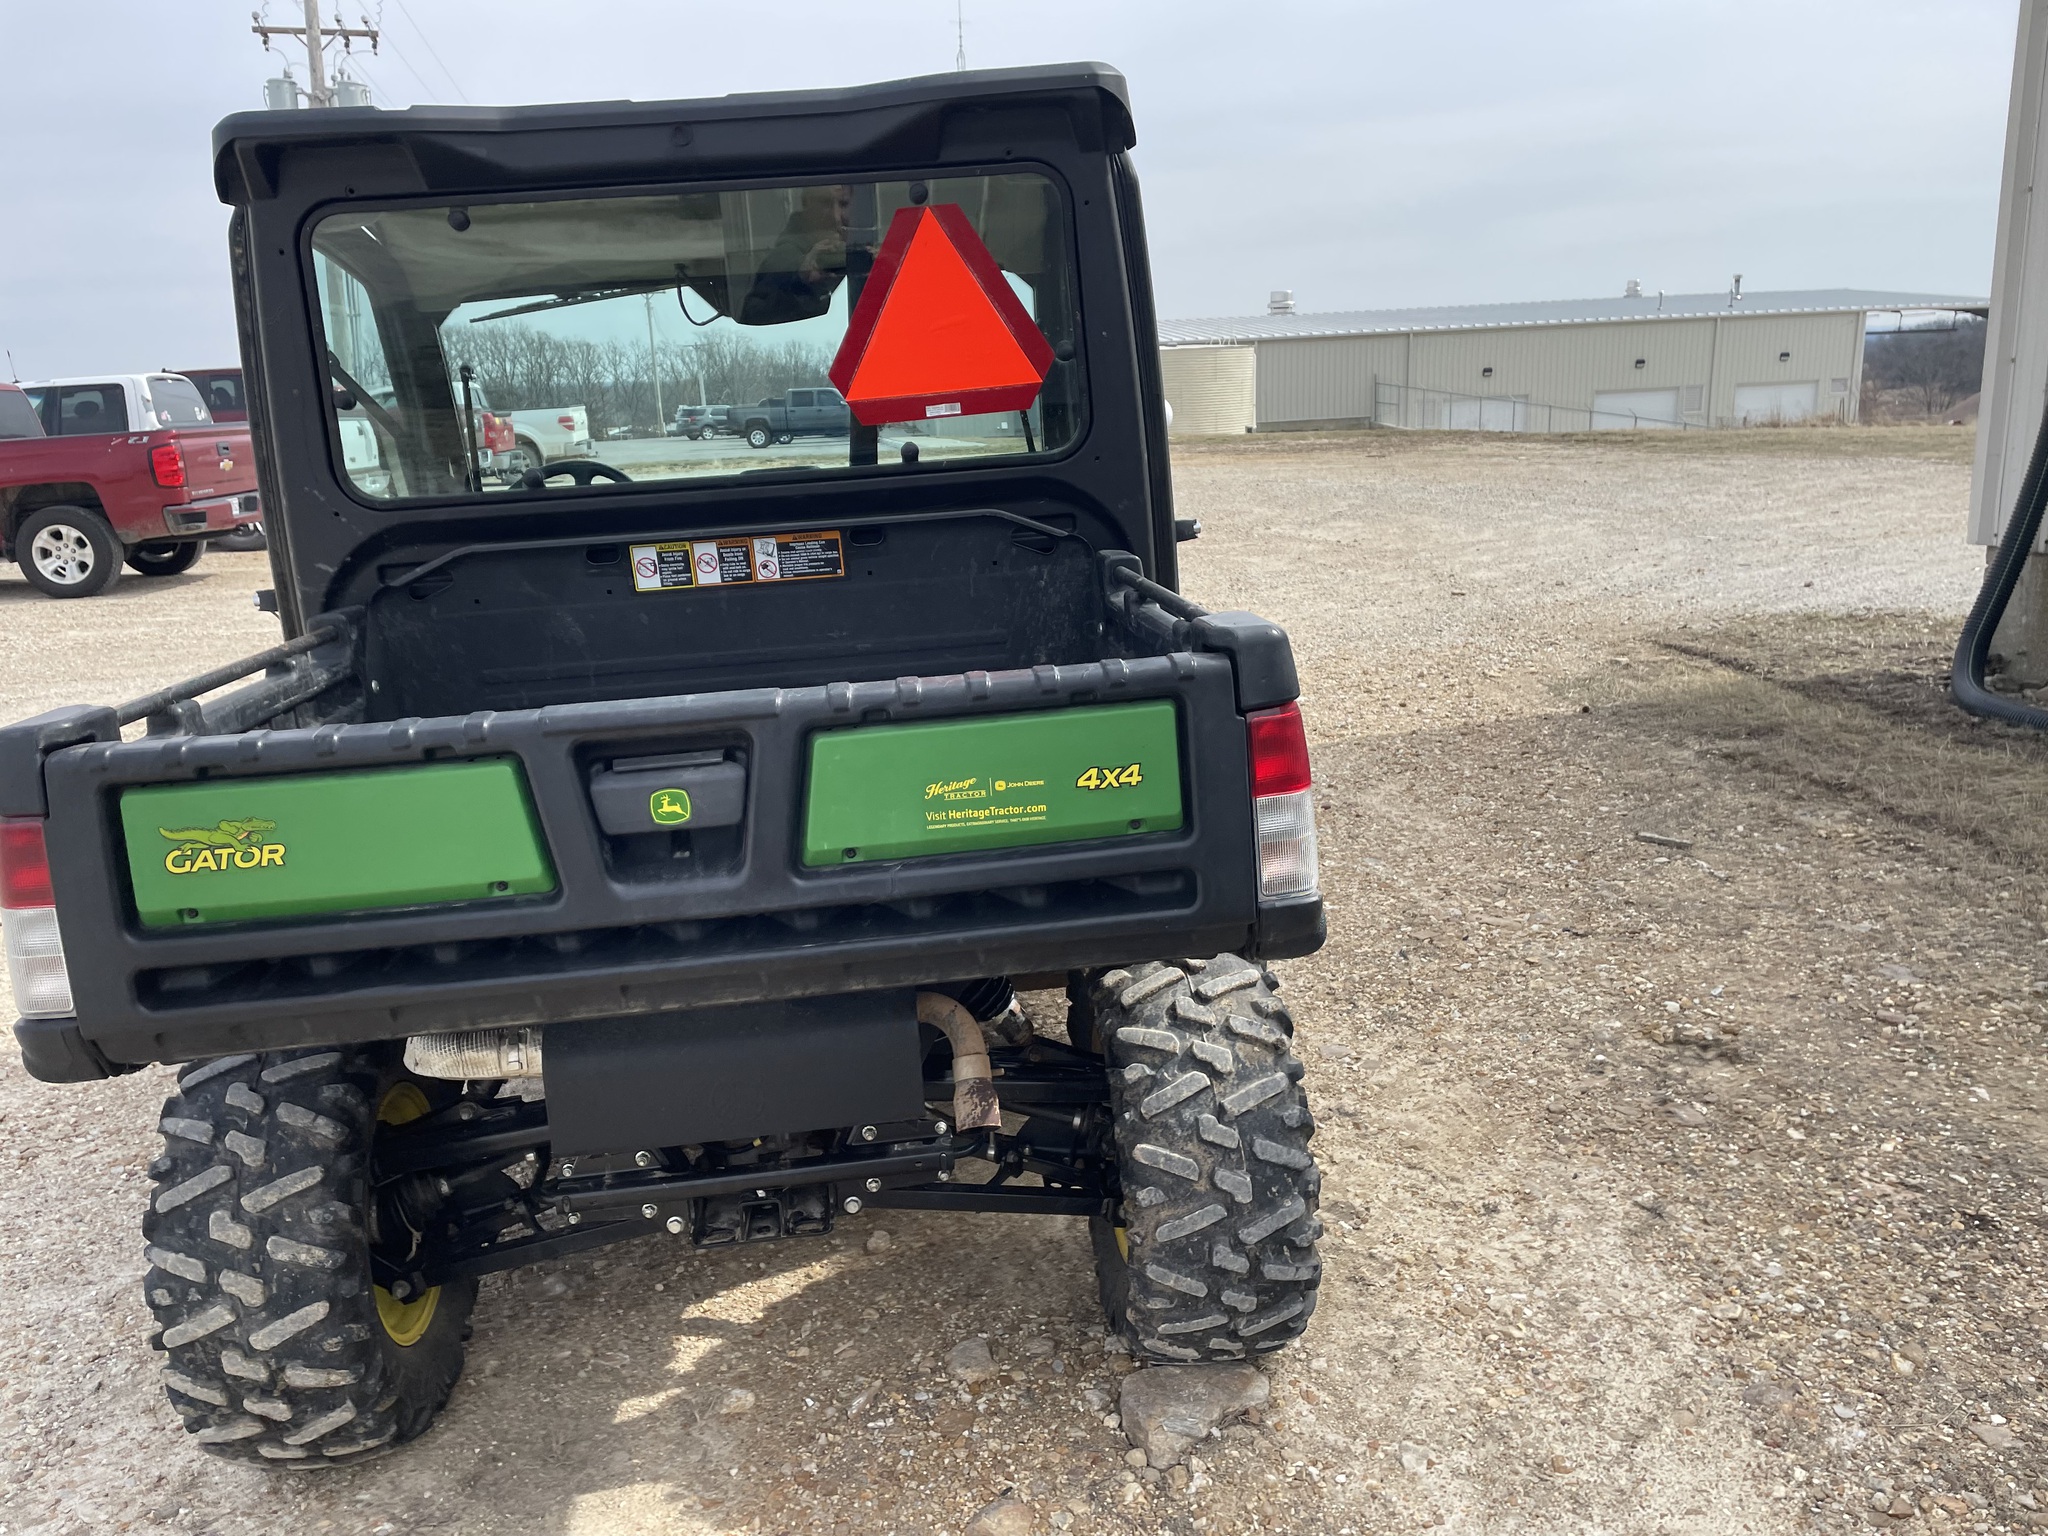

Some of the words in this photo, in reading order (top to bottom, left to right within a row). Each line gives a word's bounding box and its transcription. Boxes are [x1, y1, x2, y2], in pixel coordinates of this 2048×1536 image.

[797, 532, 823, 540] WARNING
[925, 777, 977, 800] Heritage
[944, 790, 986, 800] TRACTOR
[926, 811, 946, 821] Visit
[948, 804, 1047, 820] HeritageTractor.com
[164, 843, 286, 875] GATOR
